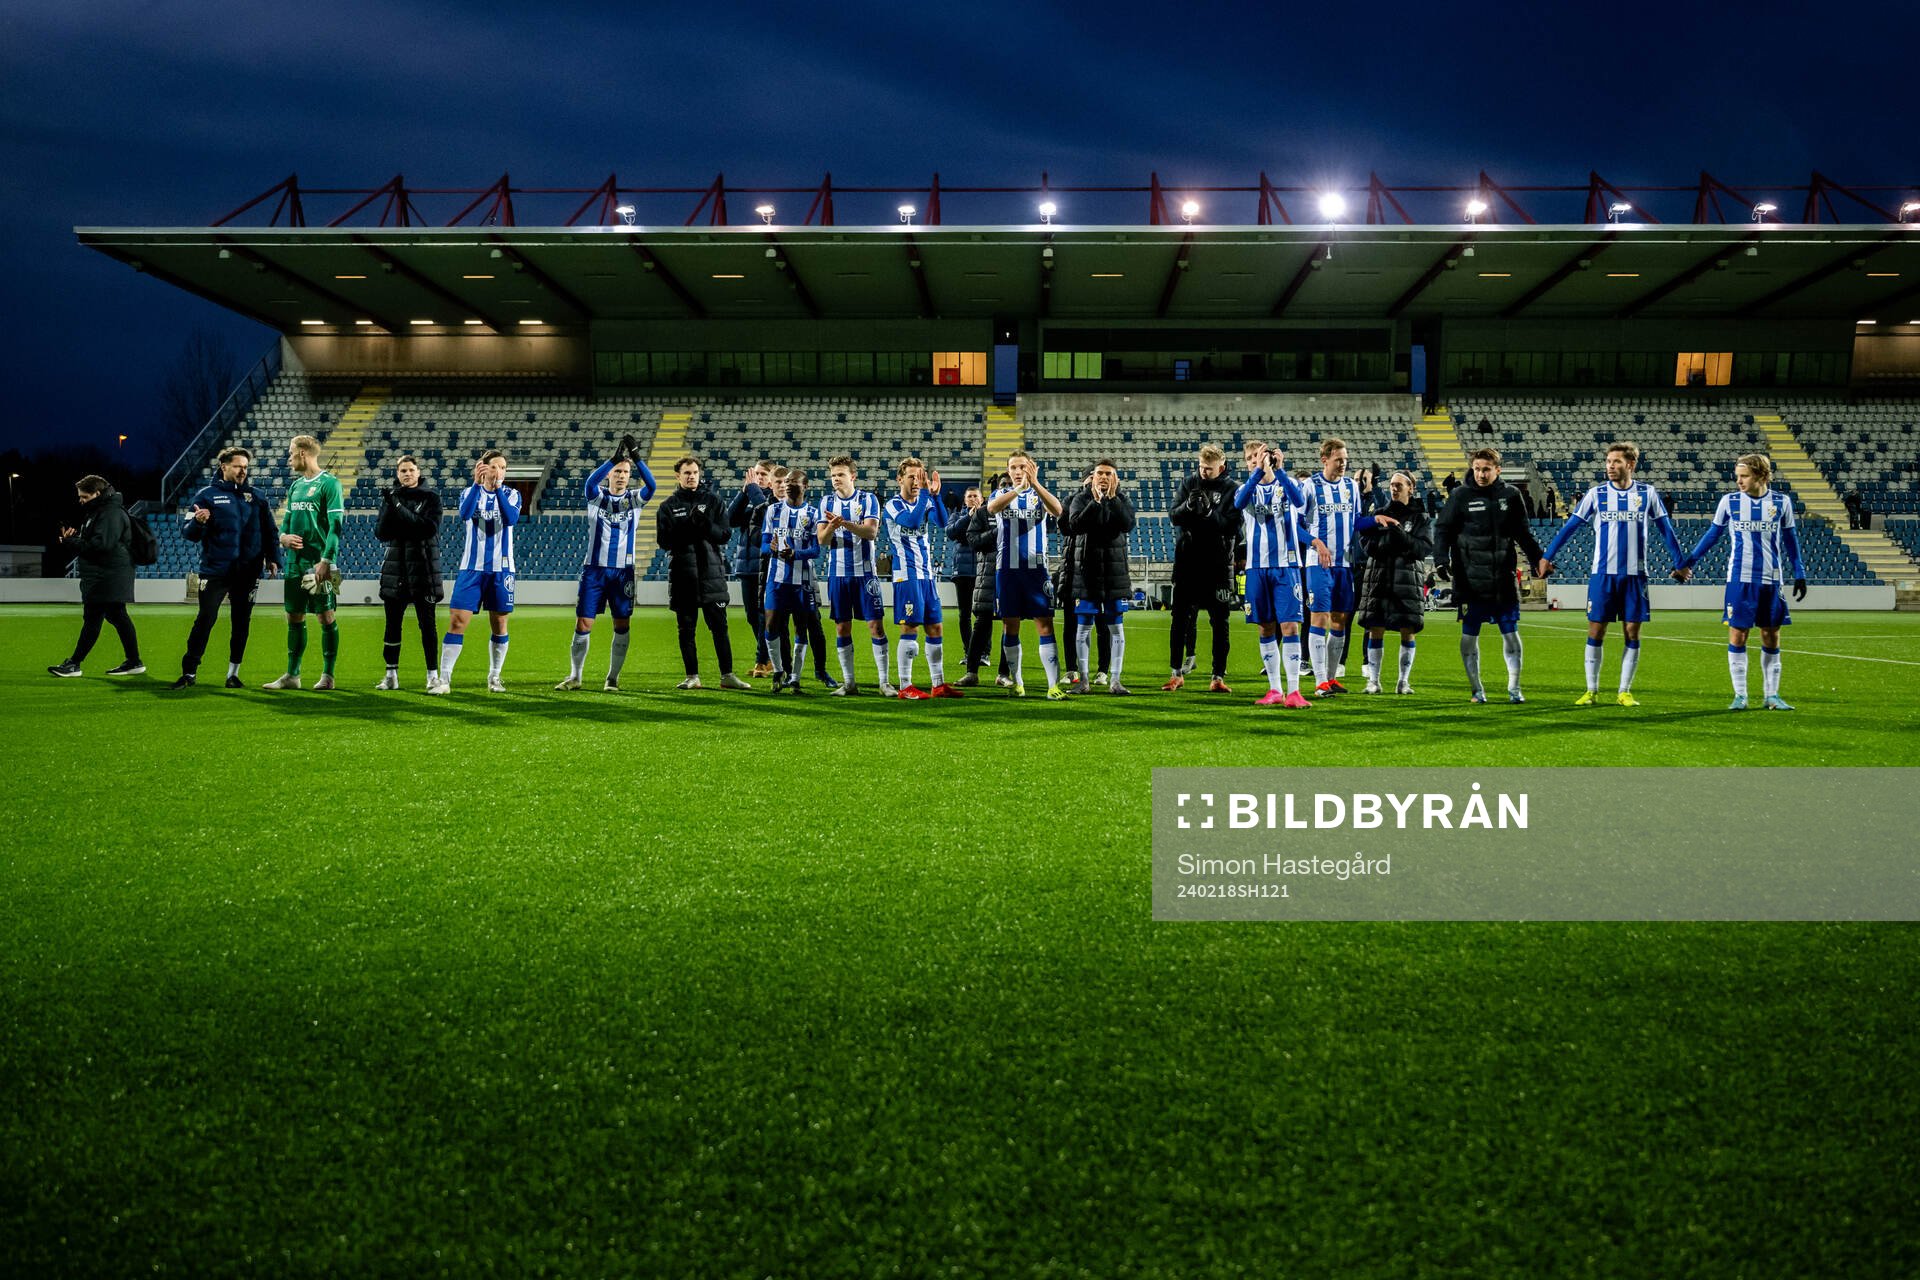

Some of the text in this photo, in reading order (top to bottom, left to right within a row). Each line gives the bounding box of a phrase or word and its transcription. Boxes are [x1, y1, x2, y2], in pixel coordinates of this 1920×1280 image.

[1319, 502, 1353, 513] SERNEKE
[1003, 508, 1041, 519] SERNEKE
[1600, 511, 1645, 521] SERNEKE
[1733, 520, 1779, 532] SERNEKE
[773, 527, 809, 540] SERNEKE
[508, 593, 514, 602] 13
[873, 597, 882, 606] 23
